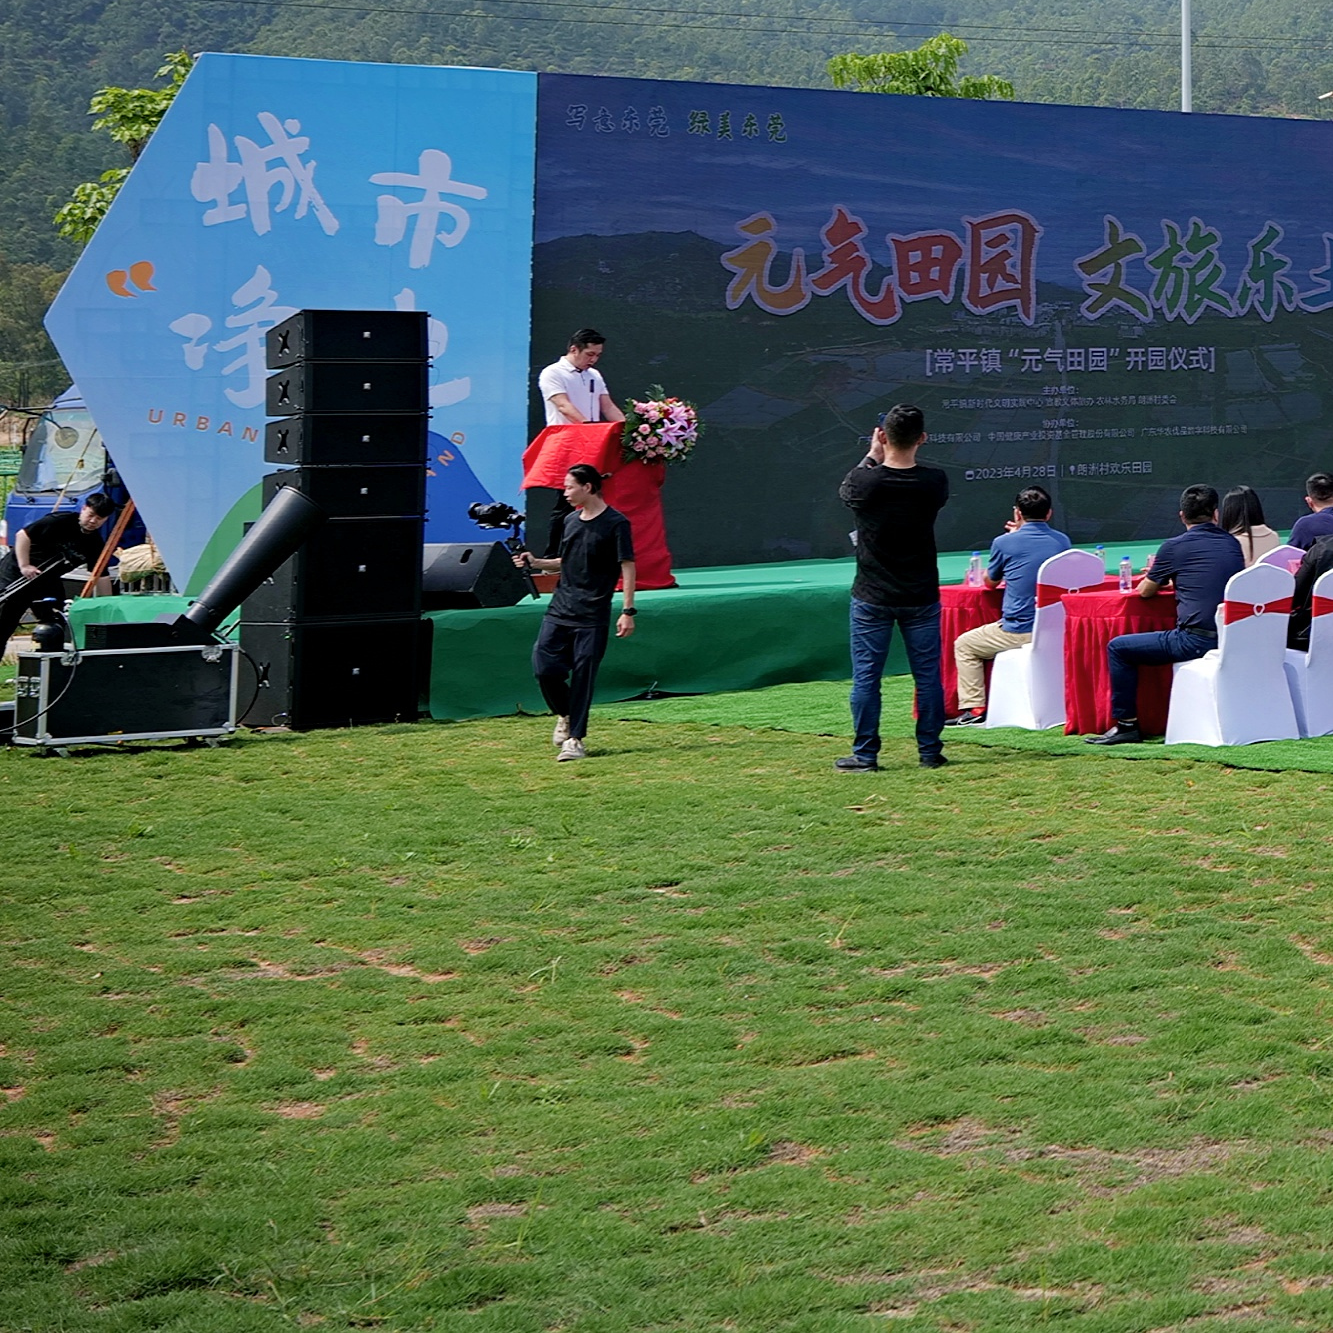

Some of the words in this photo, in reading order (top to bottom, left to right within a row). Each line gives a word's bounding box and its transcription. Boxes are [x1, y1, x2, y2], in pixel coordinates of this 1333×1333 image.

[565, 103, 672, 139] 写意东莞
[687, 109, 788, 144] 绿美东莞
[190, 111, 489, 269] 城市
[720, 203, 1045, 327] 元气田园
[147, 408, 260, 443] URBAN
[976, 466, 1056, 480] 2023年4月28日
[1077, 461, 1153, 477] 朗洲村欢乐田园
